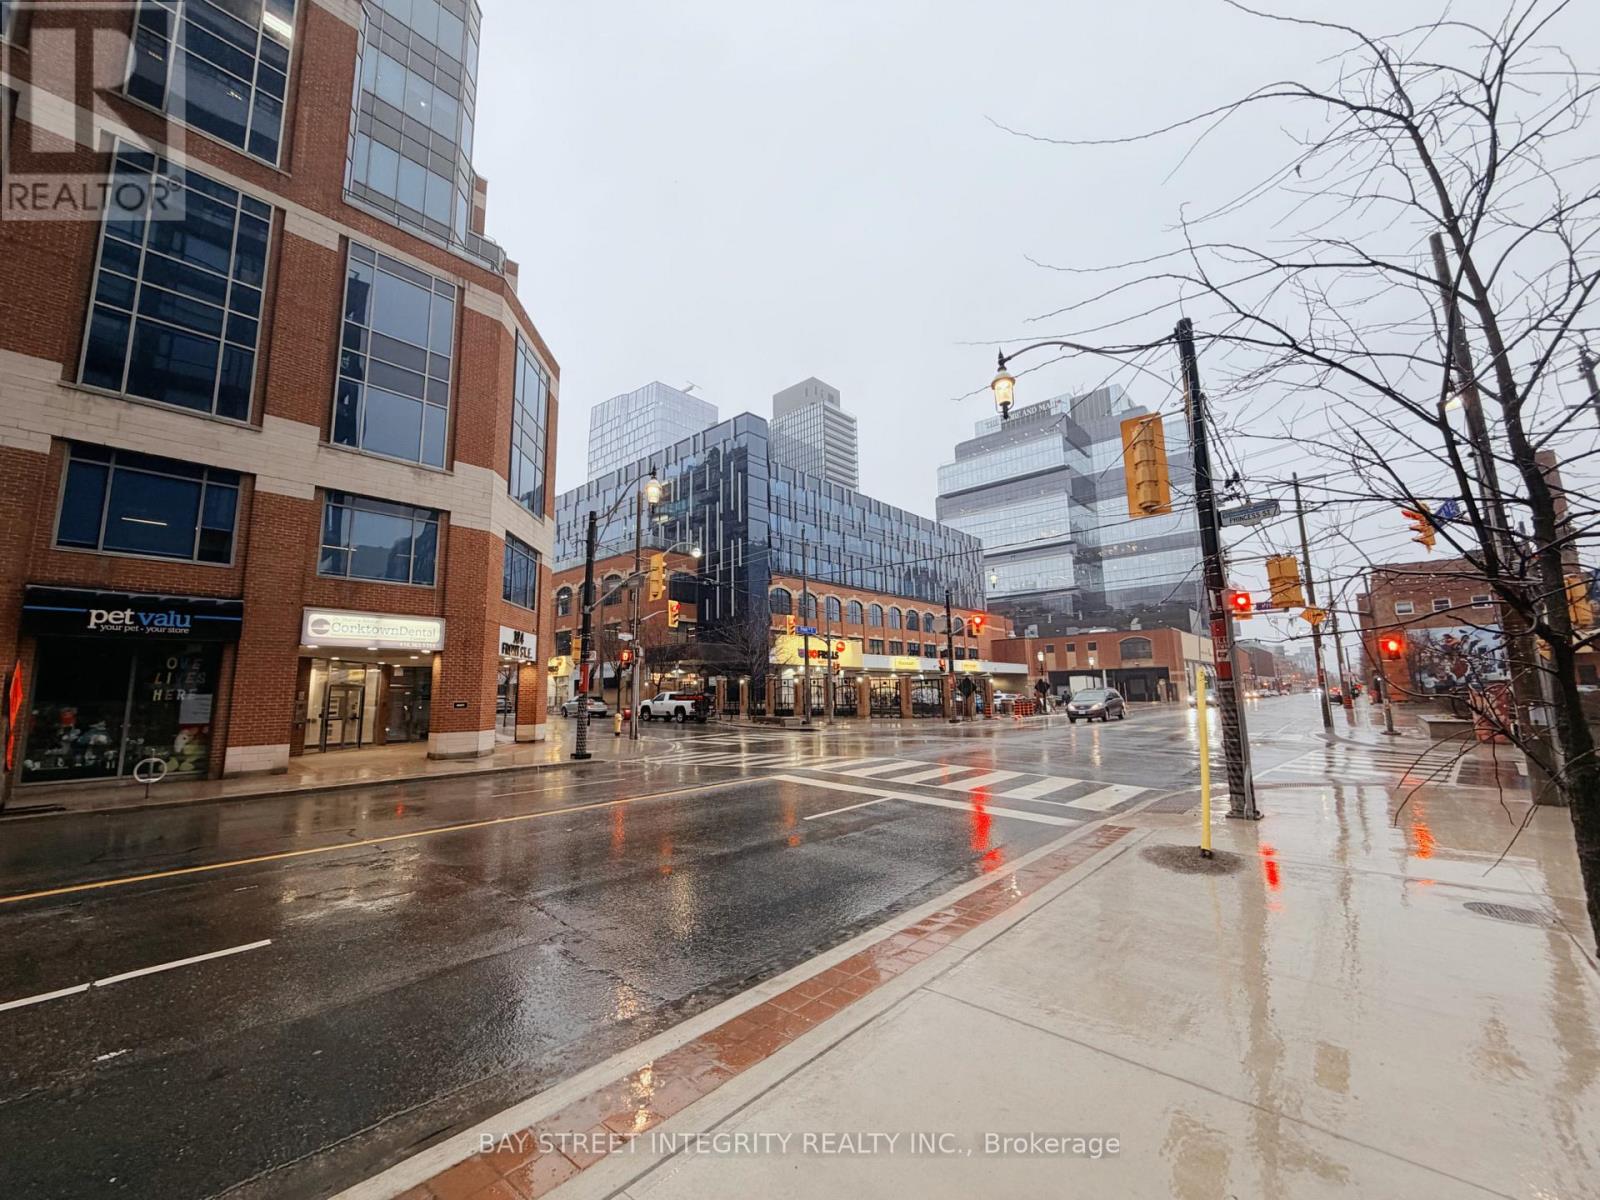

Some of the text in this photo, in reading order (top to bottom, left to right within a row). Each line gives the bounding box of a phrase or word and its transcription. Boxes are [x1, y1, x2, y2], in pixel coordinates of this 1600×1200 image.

[1022, 406, 1038, 417] AND
[1230, 511, 1261, 523] PRINCESS
[87, 608, 192, 629] pet valu
[100, 624, 122, 632] your
[145, 626, 167, 634] your
